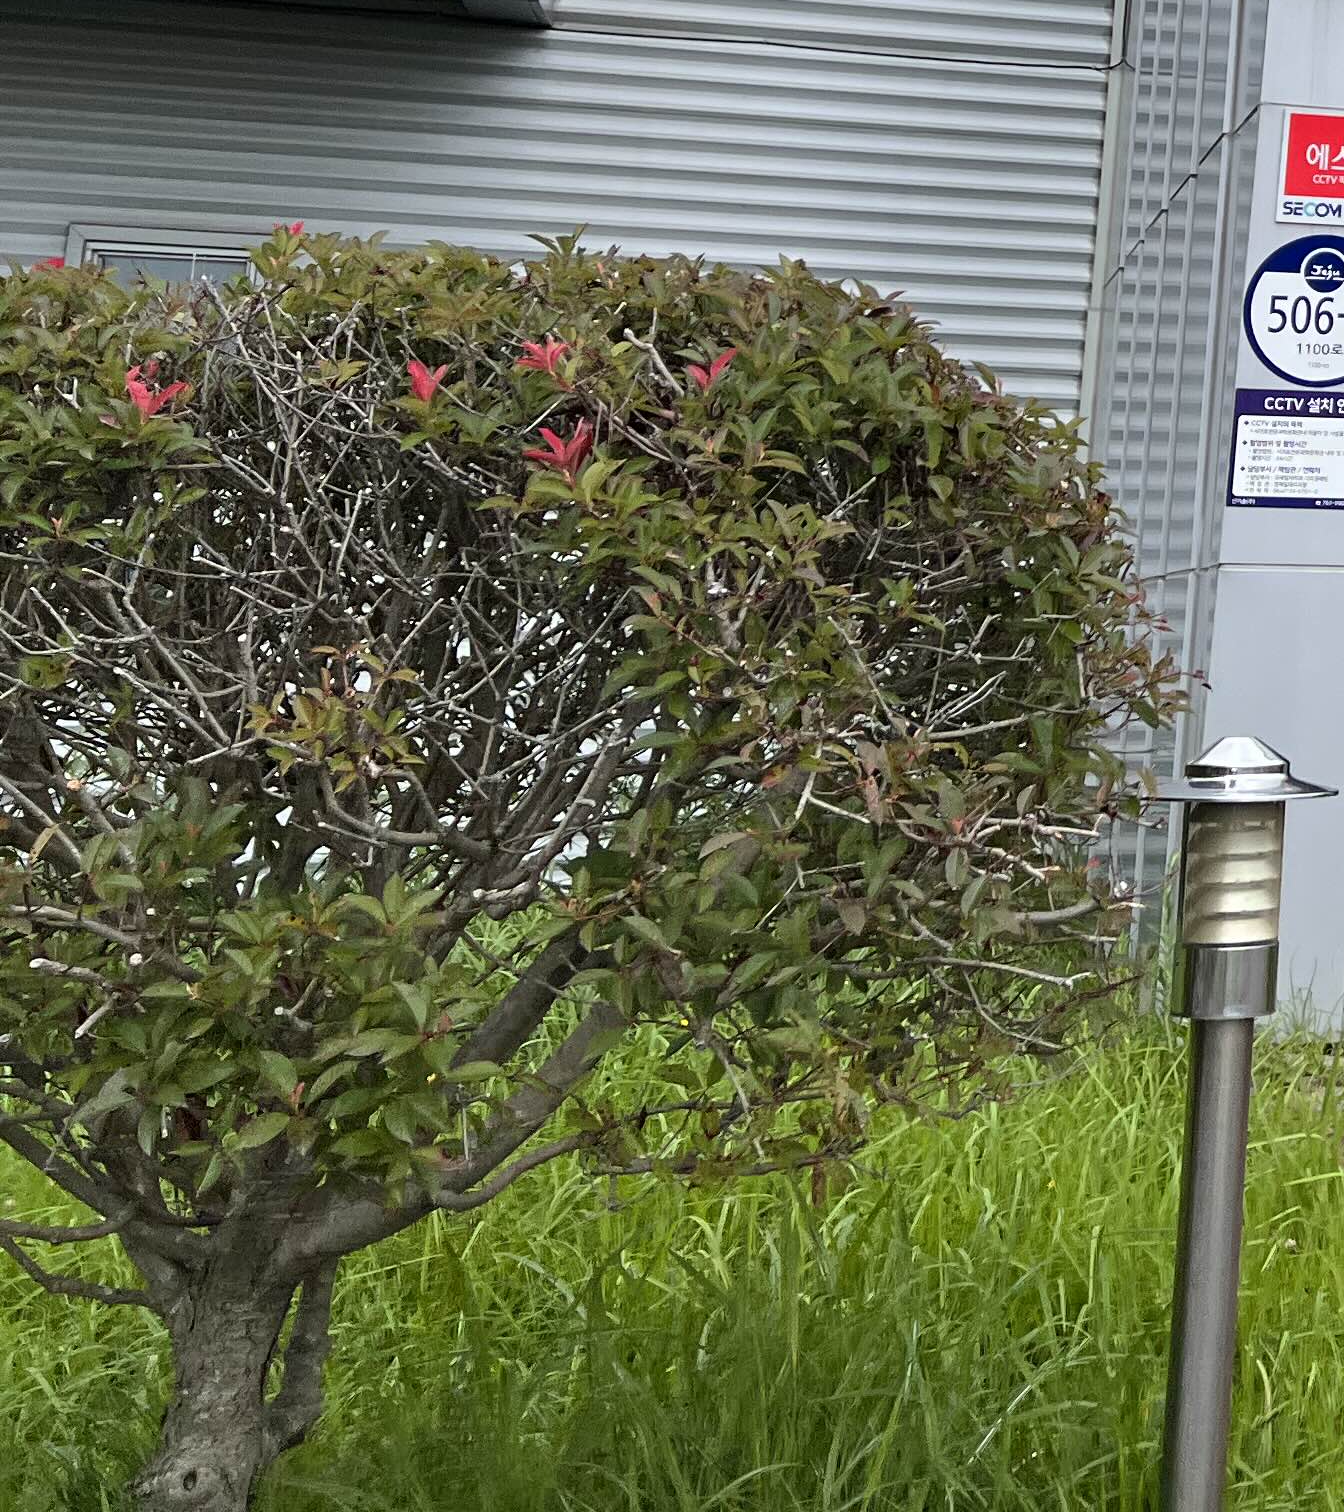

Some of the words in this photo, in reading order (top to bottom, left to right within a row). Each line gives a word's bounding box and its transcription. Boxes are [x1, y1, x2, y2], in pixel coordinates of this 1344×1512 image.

[1312, 174, 1338, 185] CCTV
[1282, 201, 1342, 219] SECOM
[1310, 264, 1341, 280] Jeju
[1297, 343, 1344, 356] 1100로
[1264, 396, 1304, 411] CCTV
[1307, 397, 1334, 414] 설치
